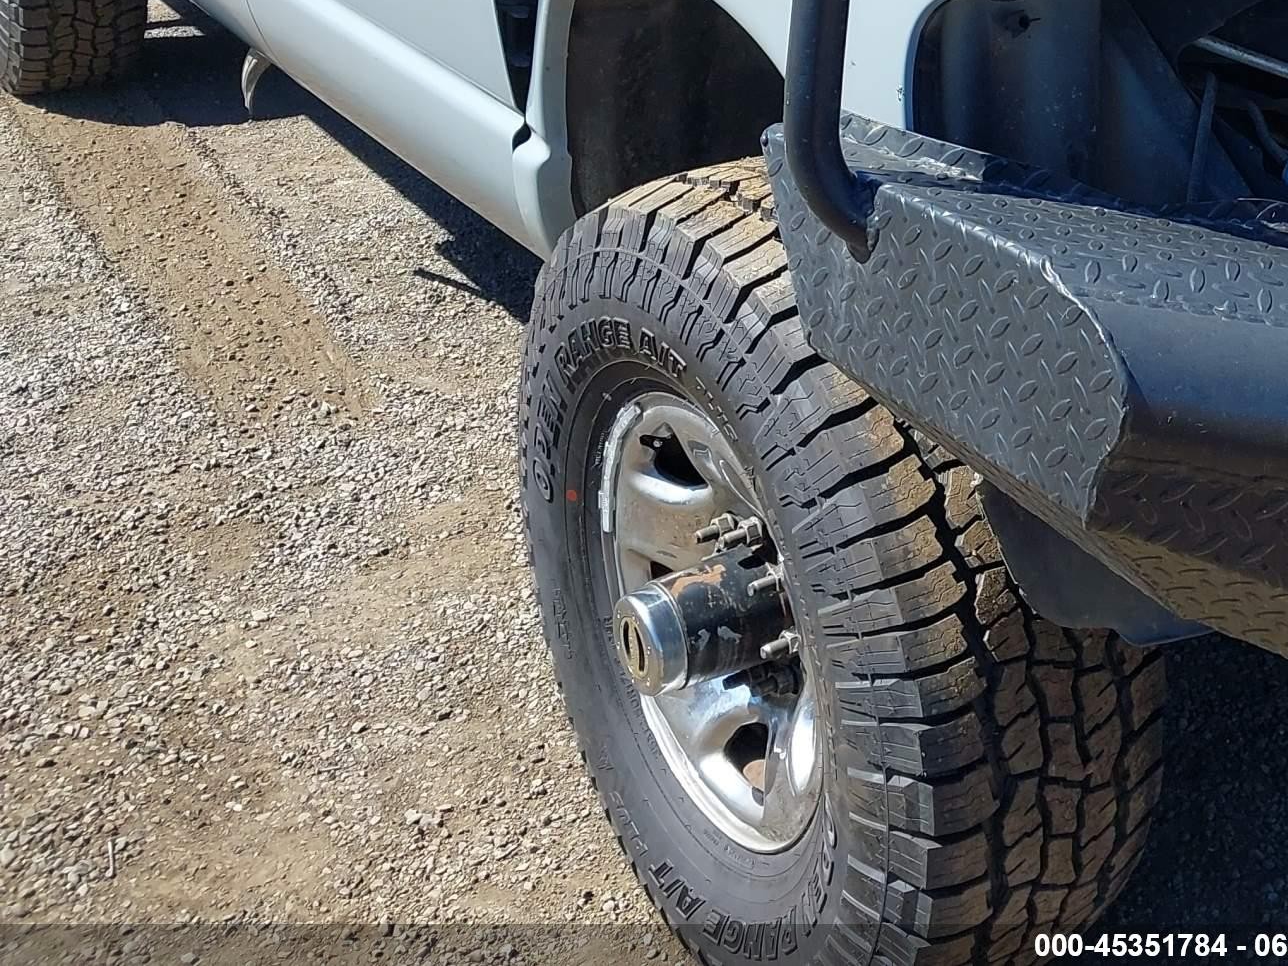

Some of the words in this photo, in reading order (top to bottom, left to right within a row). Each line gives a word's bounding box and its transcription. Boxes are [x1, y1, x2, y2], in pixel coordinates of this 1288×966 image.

[554, 316, 632, 385] RANGE
[648, 859, 706, 922] A/T
[702, 902, 799, 962] RANGE
